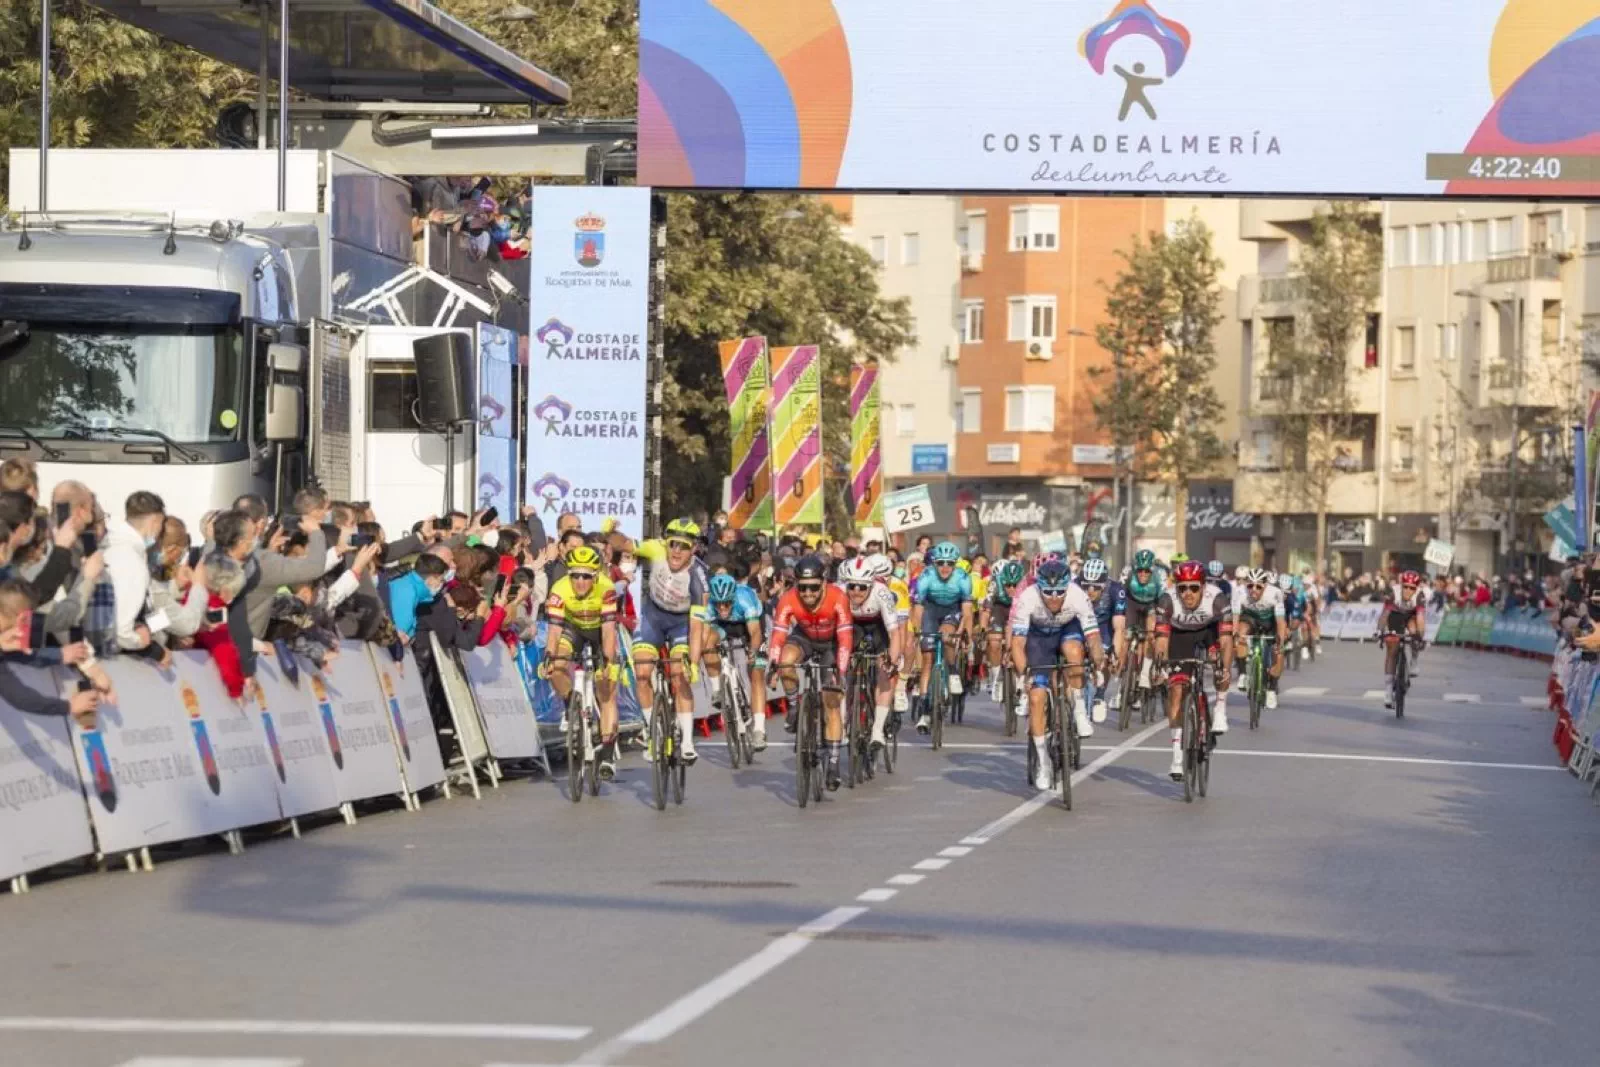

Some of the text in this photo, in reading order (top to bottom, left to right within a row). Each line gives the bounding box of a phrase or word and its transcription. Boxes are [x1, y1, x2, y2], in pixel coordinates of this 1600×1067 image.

[1031, 161, 1233, 184] deslumbrante
[1468, 156, 1562, 179] 4:22:40
[563, 346, 641, 361] ALMERÍA
[562, 423, 639, 438] ALMERÍA
[560, 500, 637, 515] ALMERÍA
[897, 505, 923, 526] 25
